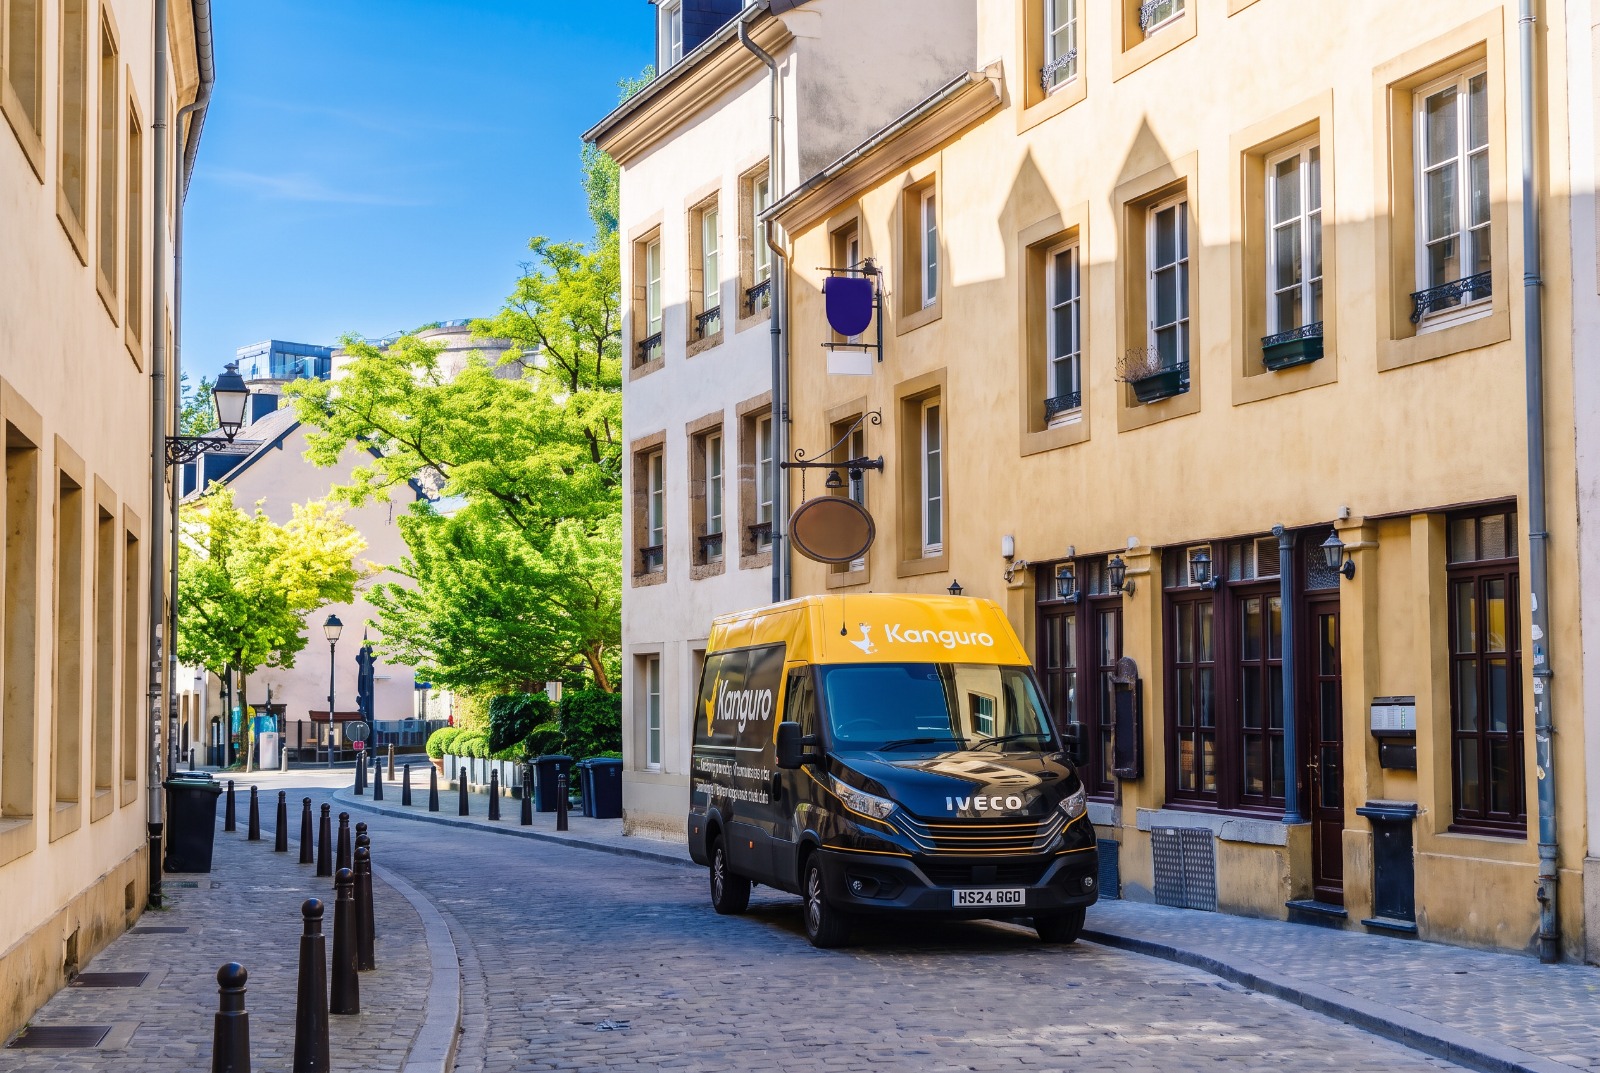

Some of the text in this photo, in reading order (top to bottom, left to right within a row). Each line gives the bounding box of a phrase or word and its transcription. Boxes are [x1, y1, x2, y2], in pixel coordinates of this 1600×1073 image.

[884, 623, 994, 649] Kanguro
[716, 679, 772, 733] Kanguro
[945, 796, 1022, 811] IVECO
[959, 891, 993, 904] HS24
